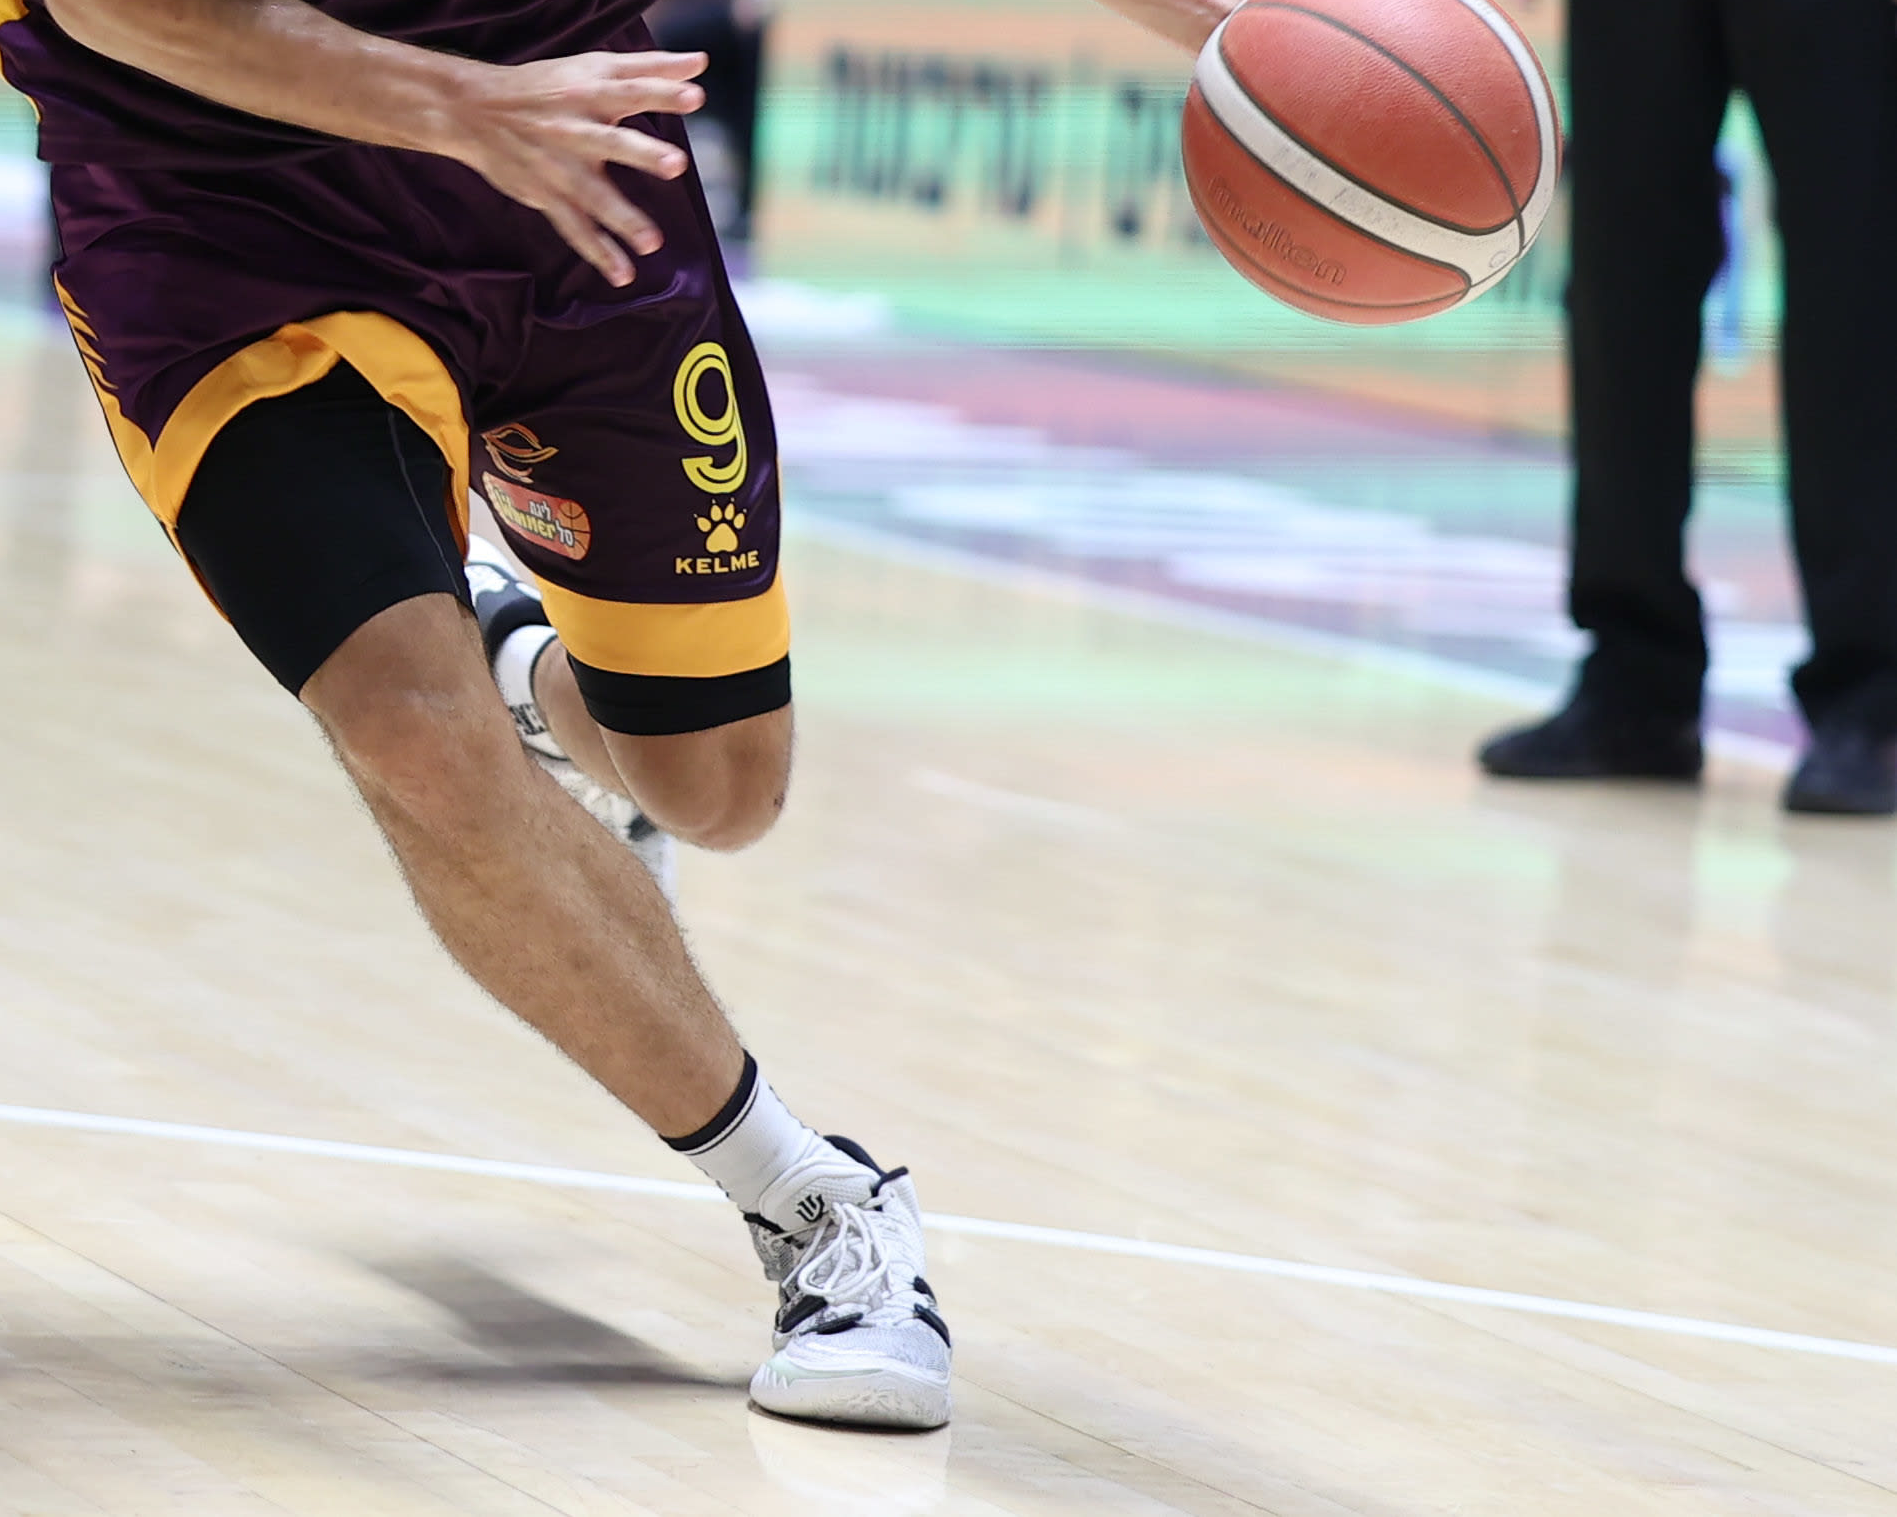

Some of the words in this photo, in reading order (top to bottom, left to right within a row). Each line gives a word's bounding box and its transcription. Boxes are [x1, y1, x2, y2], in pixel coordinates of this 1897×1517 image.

[1207, 177, 1347, 286] molten
[673, 341, 748, 494] 9
[675, 550, 760, 574] KELME
